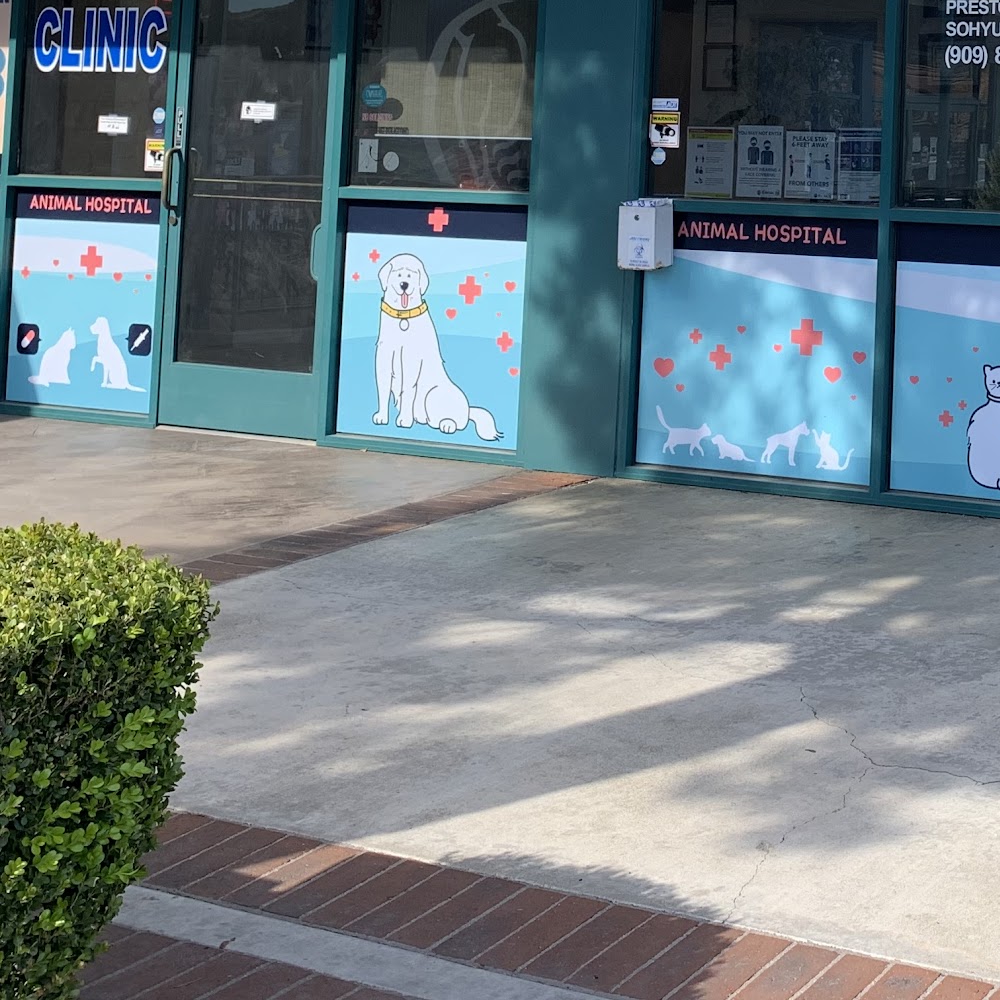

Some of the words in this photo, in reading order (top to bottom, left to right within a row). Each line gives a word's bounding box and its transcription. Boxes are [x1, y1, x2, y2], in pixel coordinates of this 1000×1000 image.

[34, 6, 168, 73] CLINIC
[944, 45, 988, 69] (909)
[29, 194, 82, 211] ANIMAL
[85, 196, 152, 214] HOSPITAL
[677, 220, 749, 240] ANIMAL
[754, 223, 847, 245] HOSPITAL
